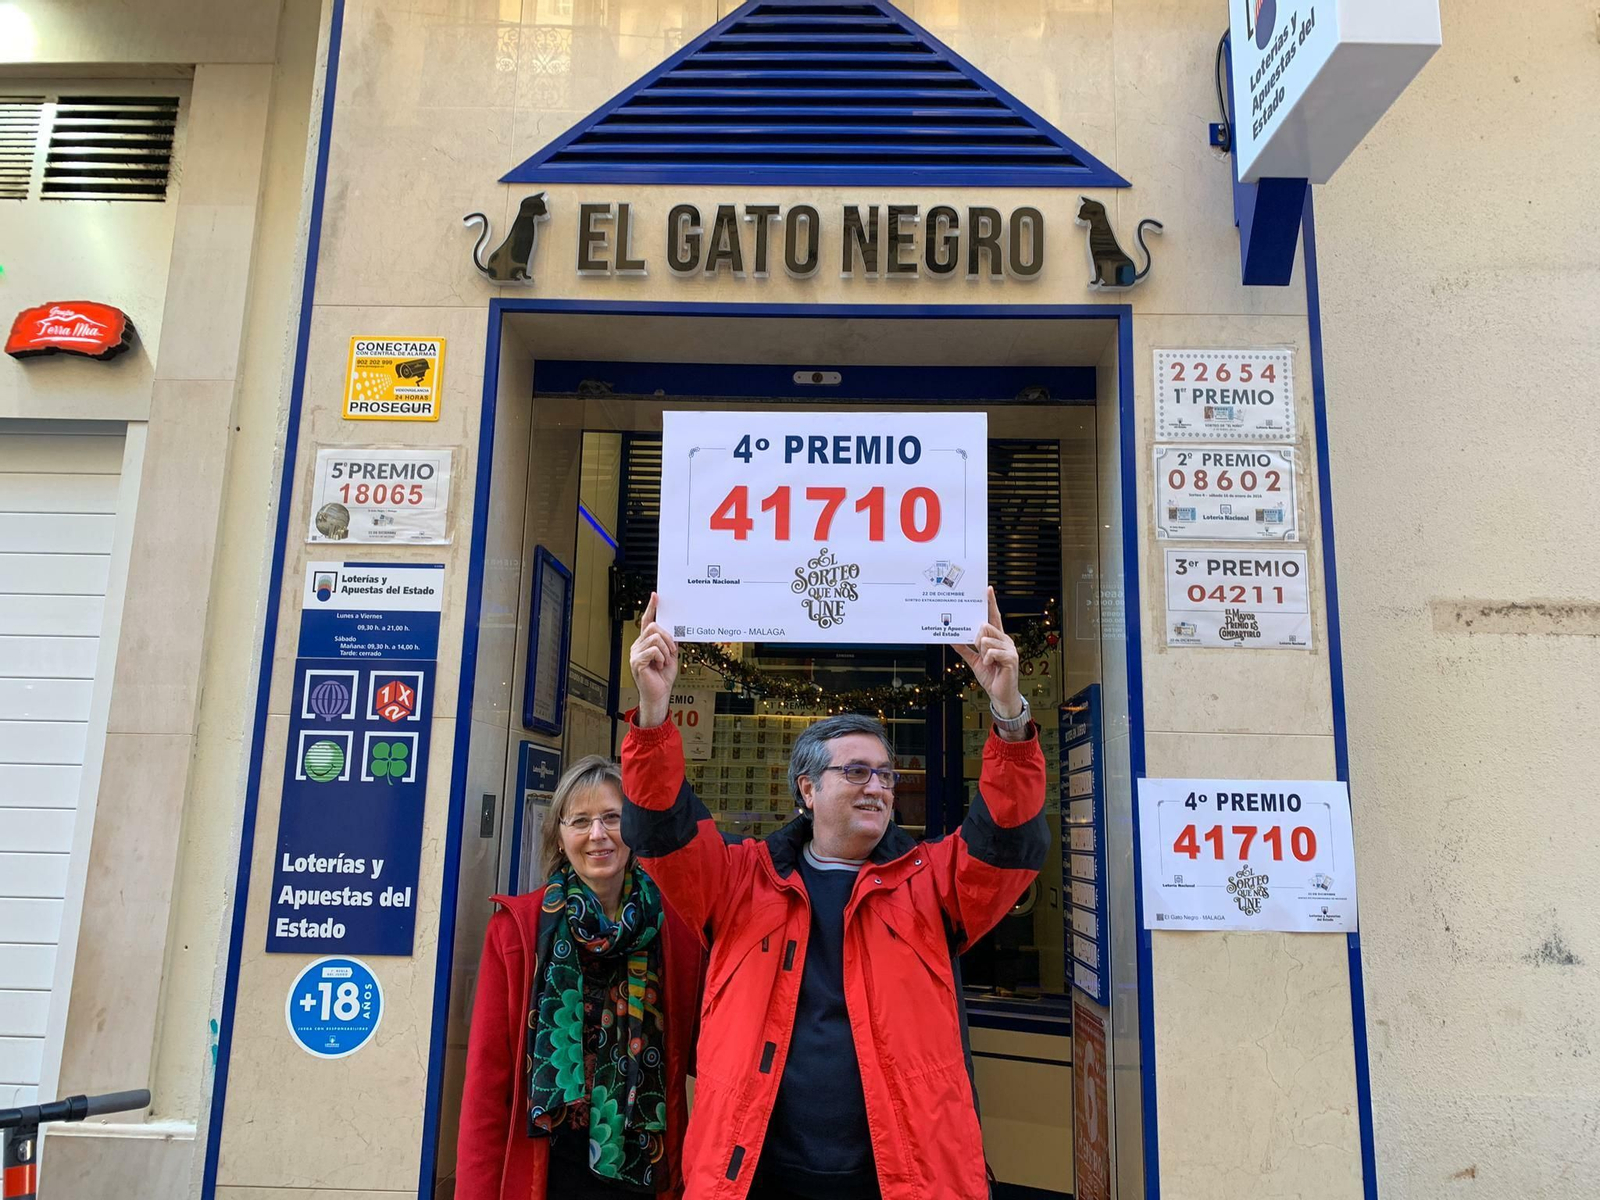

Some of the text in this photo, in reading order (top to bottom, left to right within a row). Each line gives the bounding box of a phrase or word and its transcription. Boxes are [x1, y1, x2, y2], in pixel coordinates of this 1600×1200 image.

[1250, 10, 1298, 93] Loterías y
[1252, 6, 1315, 116] Apuestas del
[1253, 85, 1285, 141] Estado
[576, 203, 1045, 281] EL GATO NEGRO
[49, 306, 75, 317] Grupo
[37, 320, 71, 336] Terra
[356, 342, 436, 352] CONECTADA
[1170, 362, 1276, 383] 22654
[1192, 388, 1274, 405] PREMIO
[349, 402, 432, 413] PROSEGUR
[733, 434, 922, 465] 4º PREMIO
[1177, 452, 1271, 467] 2º PREMIO
[348, 462, 434, 480] PREMIO
[1168, 469, 1281, 491] 08602
[339, 483, 423, 505] 18065
[709, 485, 942, 543] 41710
[807, 547, 838, 569] EL
[1175, 559, 1299, 577] 3er PREMIO
[342, 574, 388, 585] Loterías y
[791, 563, 860, 594] SORTEO
[341, 585, 434, 595] Apuestas del Estado
[808, 581, 858, 602] QUE NOS
[1187, 585, 1284, 604] 04211
[801, 599, 846, 629] UNE
[1225, 616, 1258, 631] PREMIO ES
[1232, 608, 1255, 622] MAYOR
[686, 627, 785, 637] El Gato Negro MALAGA
[1219, 627, 1261, 641] COMPARTIRLO
[398, 685, 411, 707] X
[1184, 791, 1302, 812] 4º PREMIO
[1173, 824, 1317, 862] 41710
[282, 853, 384, 880] Loterías y
[1236, 864, 1255, 878] EL
[1226, 874, 1269, 894] SORTEO
[1237, 886, 1269, 899] QUE NOS
[278, 885, 411, 910] Apuestas del
[1233, 896, 1262, 916] UNE
[275, 917, 346, 939] Estado
[299, 981, 360, 1021] +18
[362, 983, 373, 1019] AÑOS
